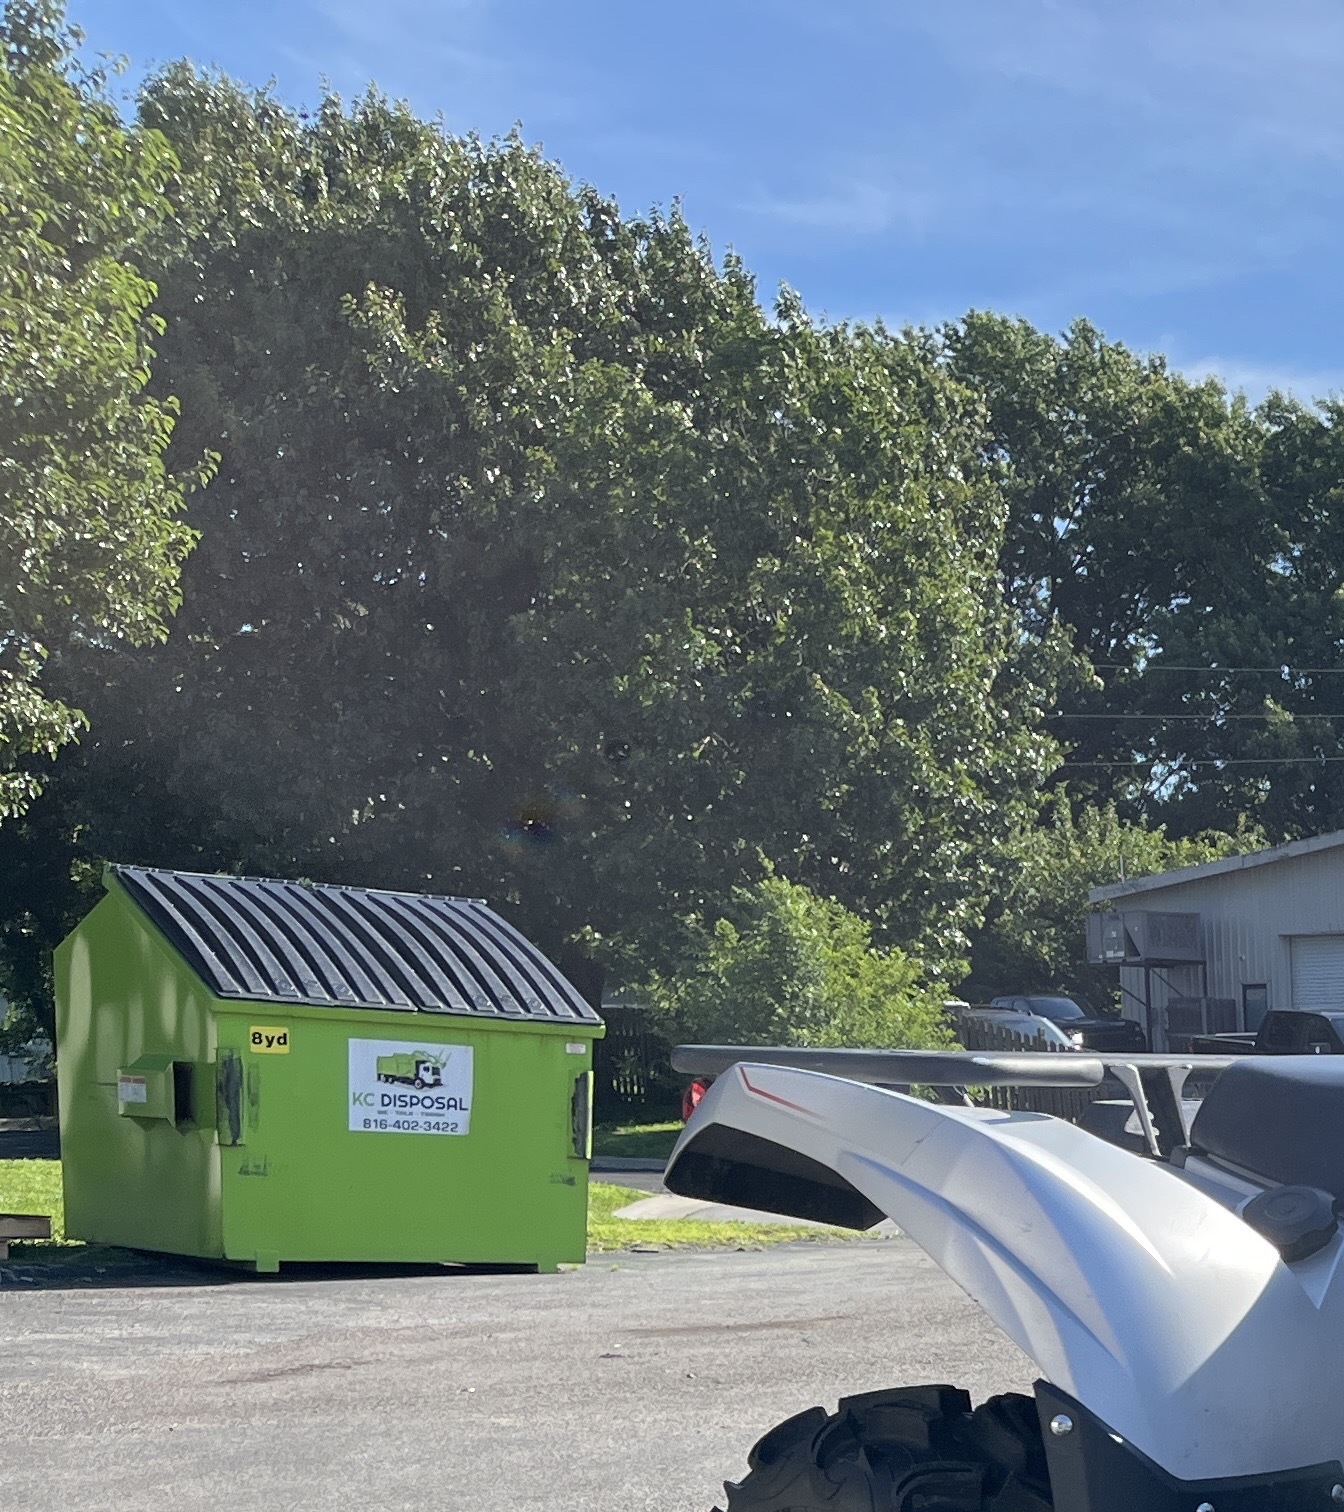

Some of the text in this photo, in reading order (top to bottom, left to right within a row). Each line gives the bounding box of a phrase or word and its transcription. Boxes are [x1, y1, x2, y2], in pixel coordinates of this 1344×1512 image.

[252, 1032, 287, 1048] 8yd
[352, 1092, 469, 1111] KC DISPOSAL
[363, 1118, 459, 1133] 816-402-3422
